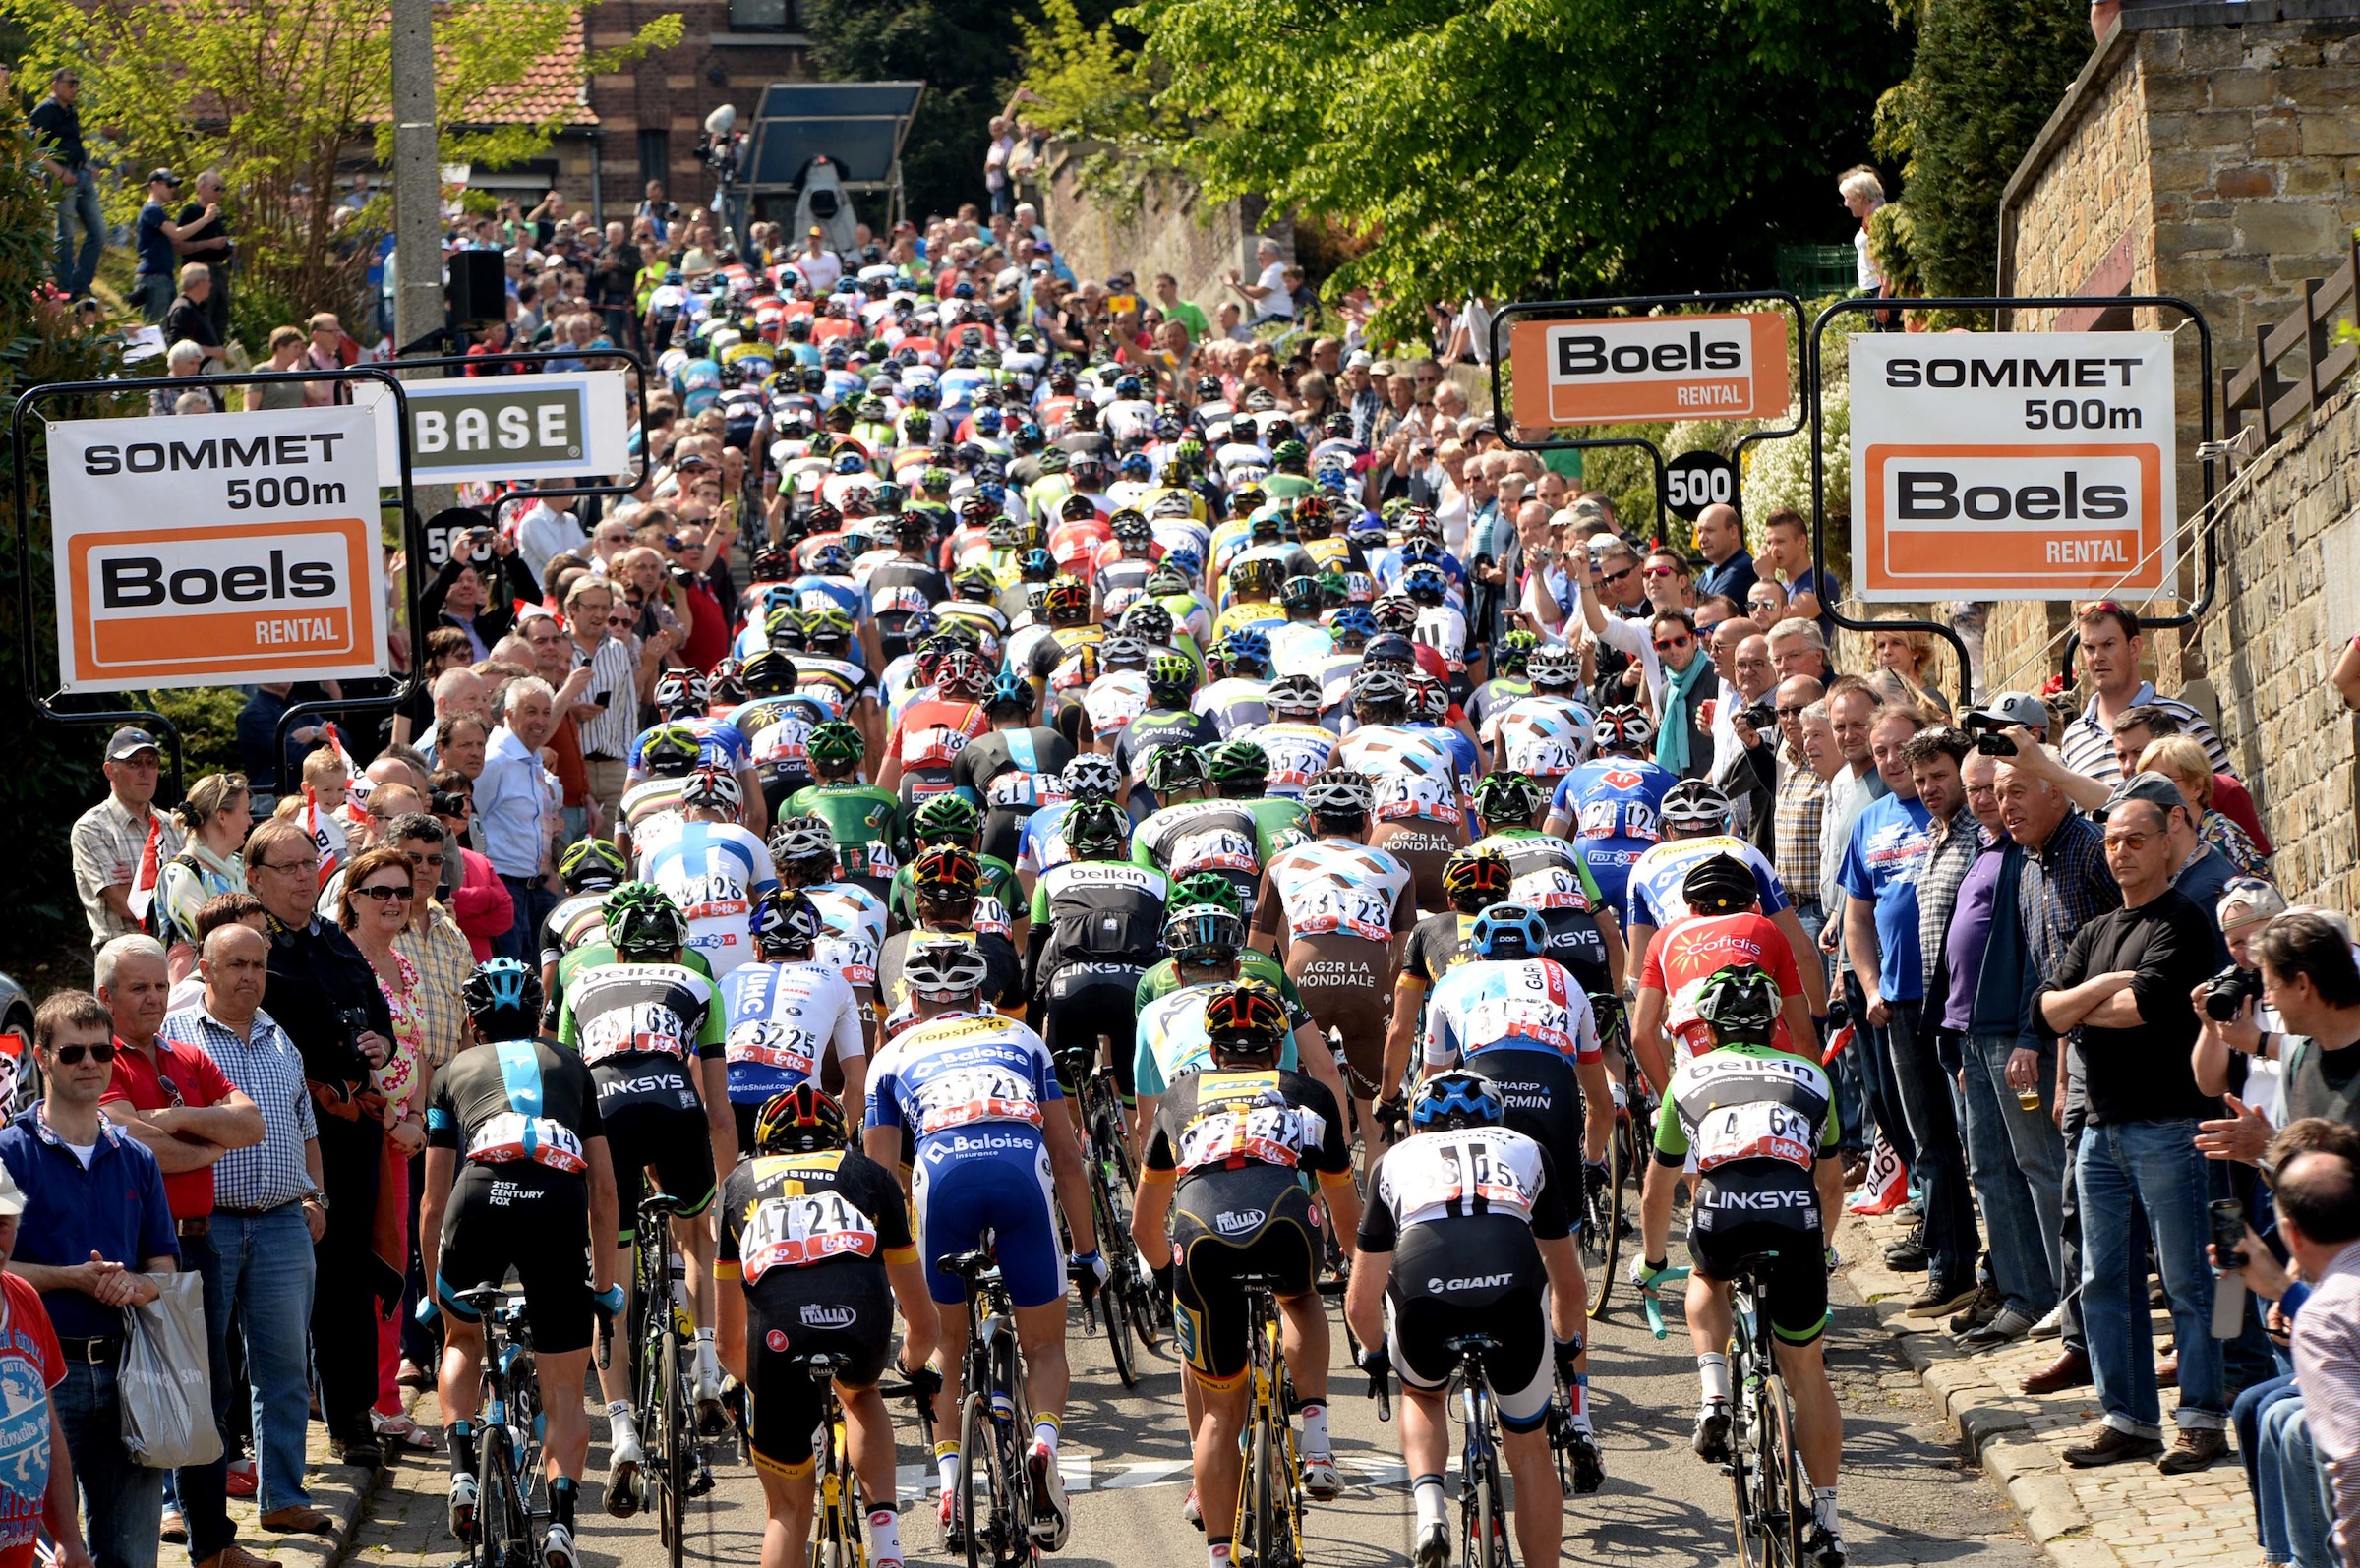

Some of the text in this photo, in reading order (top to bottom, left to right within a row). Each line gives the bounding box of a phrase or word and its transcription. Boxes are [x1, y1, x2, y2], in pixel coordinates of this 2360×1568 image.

[1559, 331, 1742, 377] Boels
[1886, 358, 2143, 388] SOMMET
[1677, 383, 1743, 407] RENTAL
[2024, 400, 2142, 431] 500m
[416, 404, 568, 454] BASE
[85, 433, 344, 477] SOMMET
[227, 476, 347, 510] 500m
[1667, 467, 1731, 504] 500
[1898, 470, 2129, 522] Boels
[2045, 539, 2129, 564] RENTAL
[101, 550, 337, 609] Boels
[255, 616, 339, 645] RENTAL
[1133, 727, 1196, 747] movistar
[1554, 746, 1576, 768] 26
[817, 786, 875, 795] Europcar
[1221, 833, 1249, 857] 63
[1382, 842, 1455, 853] MONDIALE
[1389, 832, 1449, 842] AG2R LA
[1497, 838, 1567, 852] elkin
[1070, 869, 1147, 885] belkin
[703, 876, 742, 902] 128
[710, 903, 738, 913] Lotto
[1358, 900, 1386, 927] 23
[266, 913, 283, 934] Nikon
[1687, 935, 1761, 956] Cofidis
[1304, 962, 1370, 973] AG2R LA
[1297, 974, 1376, 988] MONDIALE
[742, 972, 771, 1015] UHC
[914, 1017, 1005, 1044] Topsport
[774, 1051, 806, 1070] Lotto
[940, 1046, 1029, 1067] Baloise
[945, 1057, 990, 1069] Insurance
[1689, 1060, 1814, 1083] belkin
[596, 1074, 685, 1099] LINKSYS
[728, 1081, 794, 1092] AegisShield.com
[1504, 1095, 1552, 1110] RMIN
[1770, 1108, 1803, 1143] 64
[547, 1123, 578, 1155] 14
[953, 1133, 1034, 1152] Baloise
[1771, 1138, 1804, 1160] Lotto
[955, 1150, 999, 1160] Insurance
[492, 1180, 519, 1191] 21ST
[756, 1169, 836, 1193] SAMSUNG
[489, 1196, 511, 1207] FOX
[490, 1189, 545, 1199] CENTURY
[1704, 1190, 1812, 1210] LINKSYS
[745, 1204, 791, 1260] 247
[1217, 1212, 1259, 1233] ITALIA
[821, 1234, 864, 1253] Lotto
[753, 1245, 790, 1274] Lotto
[1446, 1273, 1513, 1290] GIANT
[799, 1303, 822, 1311] selle
[800, 1308, 851, 1324] ITALIA
